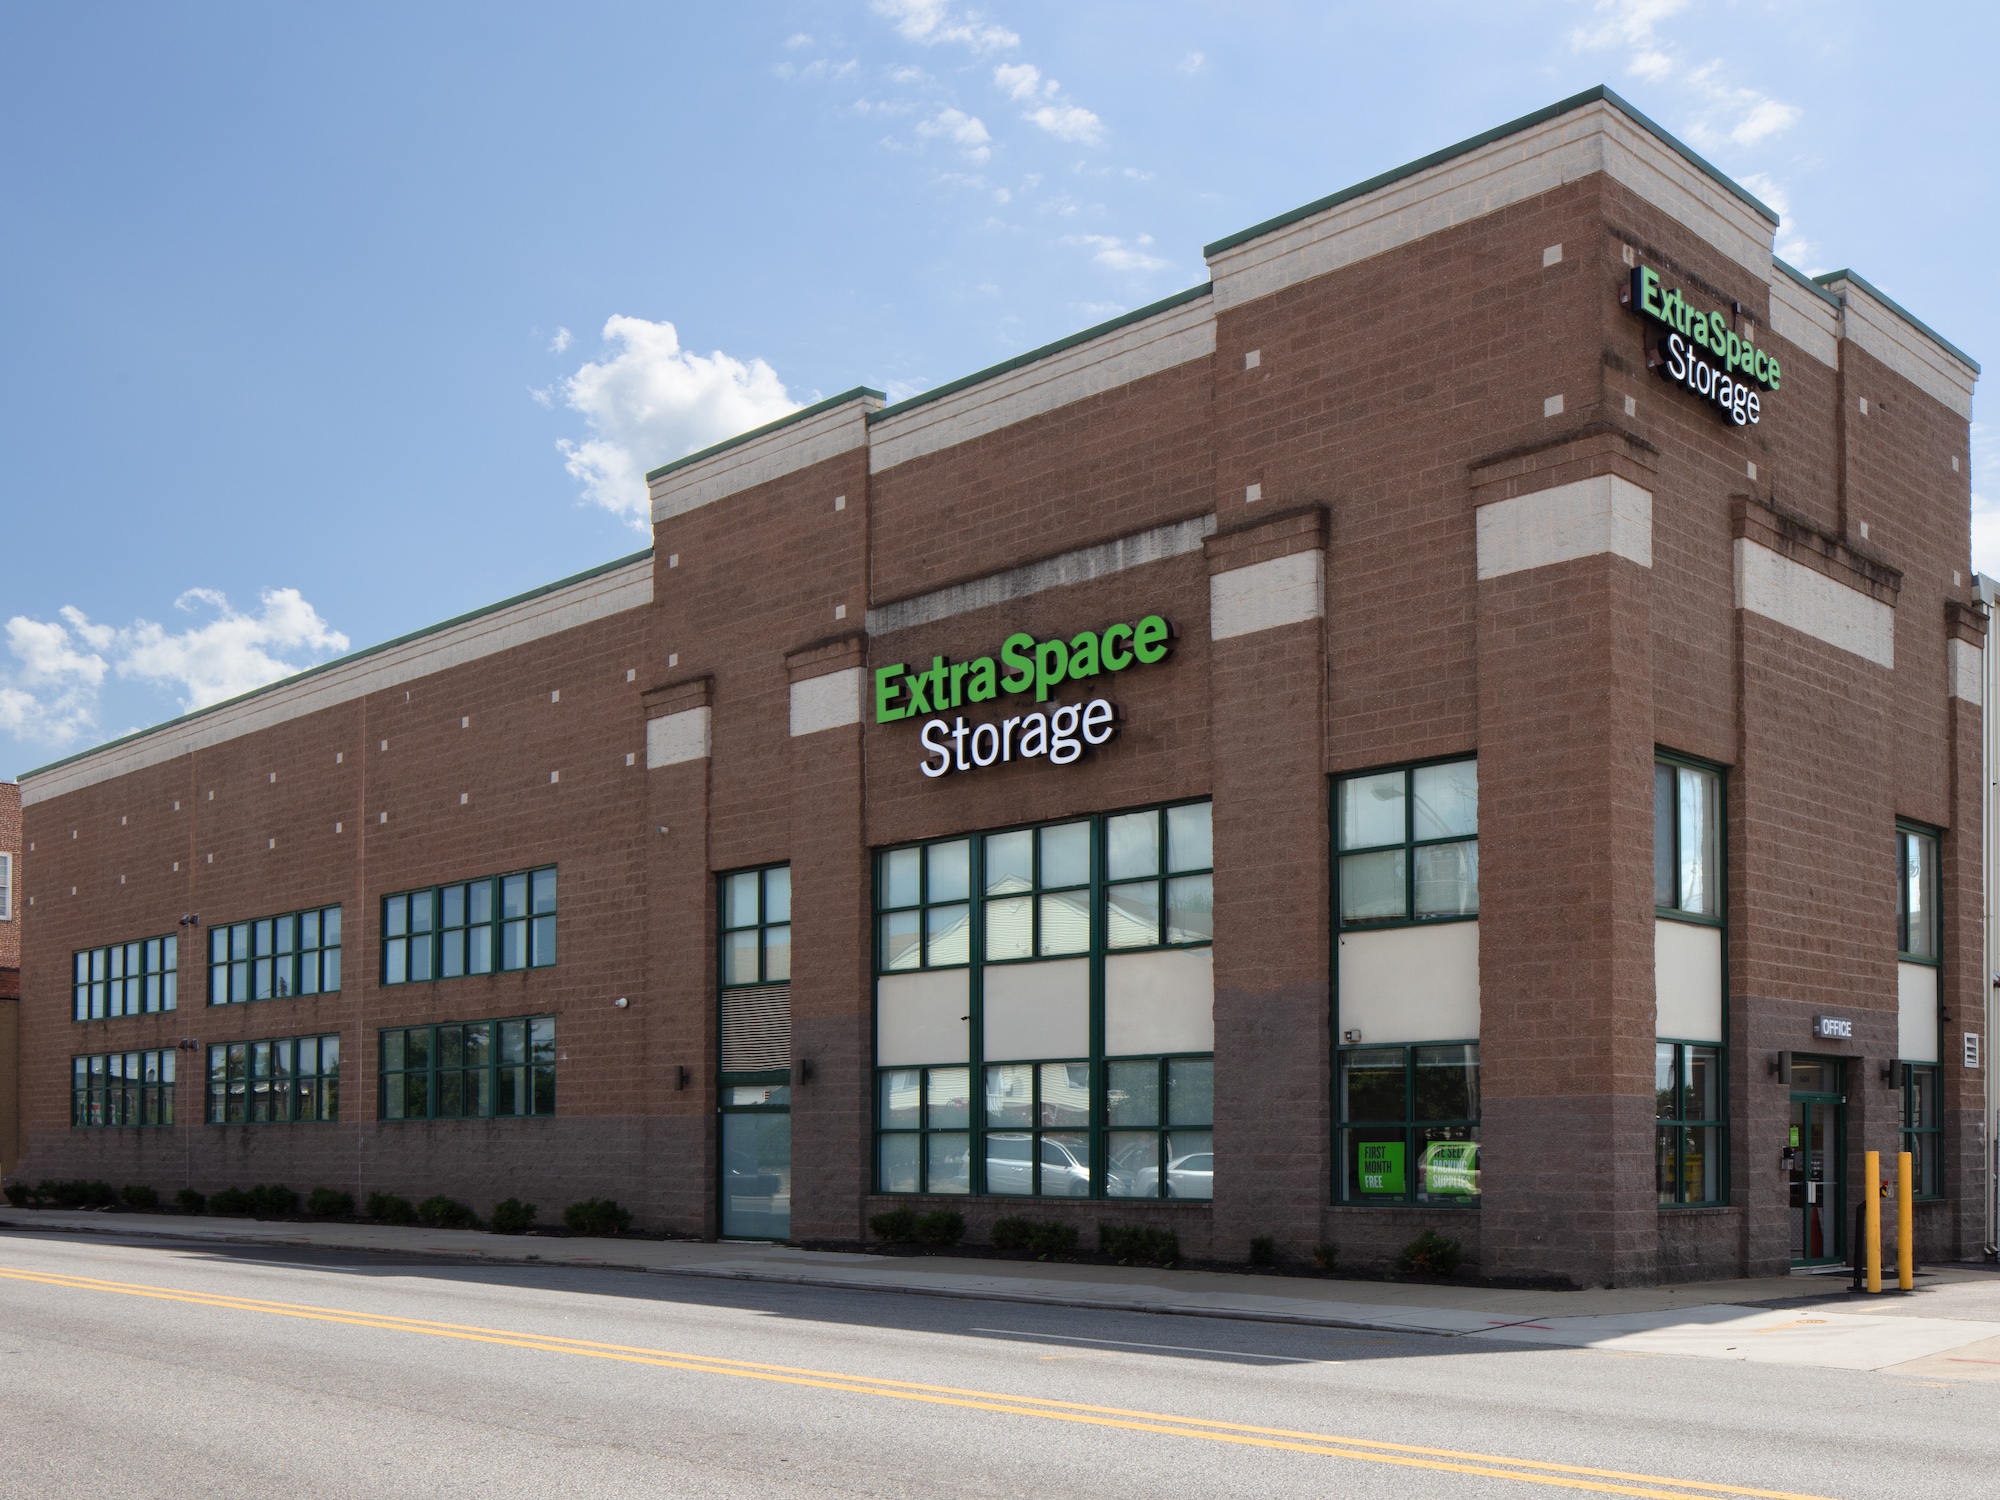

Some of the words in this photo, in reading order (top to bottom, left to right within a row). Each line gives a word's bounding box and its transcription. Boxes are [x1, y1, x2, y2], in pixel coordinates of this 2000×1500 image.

[1641, 265, 1781, 390] ExtraSpace
[1666, 333, 1760, 425] Storage
[875, 615, 1169, 724] ExtraSpace
[920, 698, 1113, 778] Storage
[1823, 1019, 1852, 1037] OFFICE
[1364, 1146, 1386, 1159] FIRST
[1433, 1145, 1445, 1158] WE
[1447, 1145, 1465, 1158] SELL
[1364, 1160, 1392, 1174] MONTH
[1433, 1160, 1467, 1174] PACKING
[1364, 1175, 1383, 1189] FREE
[1433, 1175, 1471, 1188] SUPPLIES
